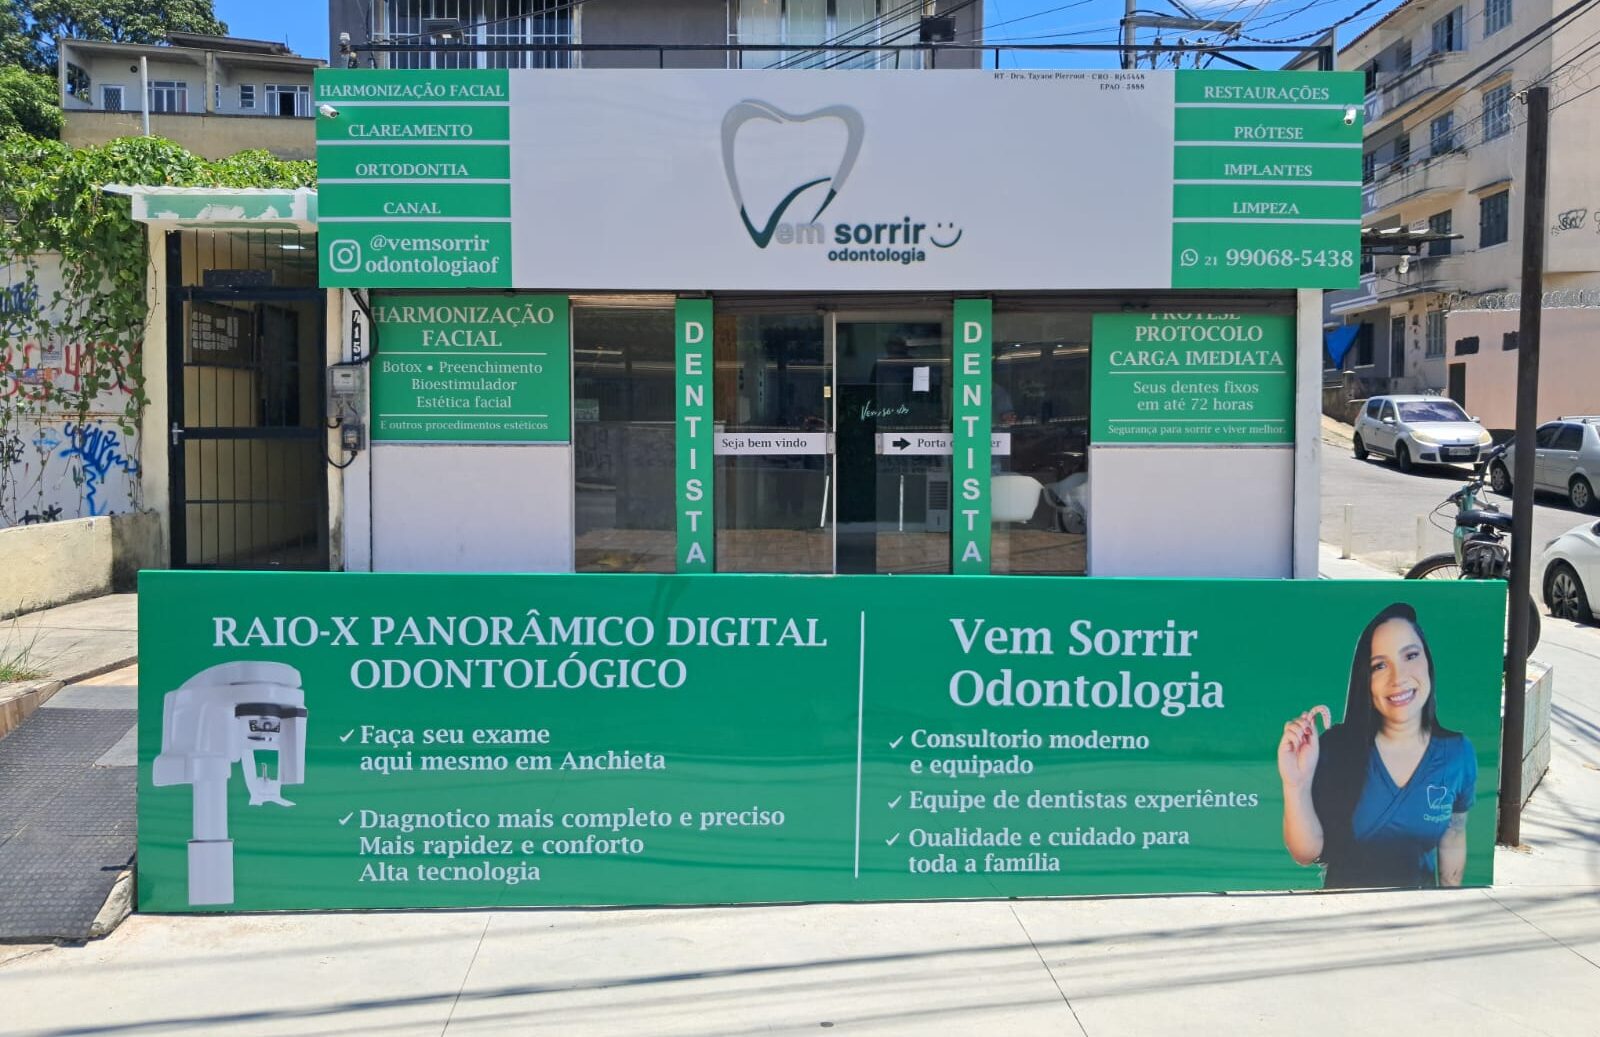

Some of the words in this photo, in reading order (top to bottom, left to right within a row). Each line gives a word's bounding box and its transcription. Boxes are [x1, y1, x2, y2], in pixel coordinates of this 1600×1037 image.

[320, 83, 445, 98] HARMONIZAÇÃO
[451, 85, 504, 96] FACIAL
[1205, 85, 1329, 102] RESTAURAÇÕES
[348, 125, 472, 136] CLAREAMENTO
[1235, 125, 1303, 139] PRÓTESE
[356, 164, 468, 176] ORTODONTIA
[1225, 164, 1312, 176] IMPLANTES
[384, 203, 440, 214] CANAL
[1233, 202, 1299, 214] LIMPEZA
[834, 216, 926, 244] sorrir
[370, 235, 489, 251] @vemsorrir
[828, 247, 926, 265] odontologia
[1205, 256, 1217, 265] 21
[1226, 249, 1353, 267] 99068-5438
[365, 256, 499, 276] odontologiaof
[371, 303, 554, 328] HARMONIZAÇÃO
[423, 330, 502, 346] FACIAL
[1136, 326, 1262, 341] PROTOCOLO
[383, 361, 422, 372] Botox
[440, 361, 542, 373] Preenchimento
[1110, 351, 1179, 366] CARGA
[1186, 351, 1282, 365] IMEDIATA
[412, 378, 517, 390] Bioestimulador
[1133, 381, 1166, 394] Seus
[1171, 381, 1219, 393] dentes
[1224, 381, 1259, 393] fixos
[417, 396, 470, 407] Estética
[476, 396, 511, 408] facial
[1137, 400, 1159, 410] em
[1164, 398, 1185, 410] até
[1191, 398, 1208, 410] 72
[1213, 398, 1254, 410] horas
[380, 420, 386, 430] E
[389, 420, 422, 430] outros
[425, 419, 501, 432] procedimentos
[504, 420, 548, 430] estéticos
[1108, 425, 1157, 435] Segurança
[1160, 427, 1182, 436] para
[1184, 425, 1211, 434] sorrir
[1223, 425, 1246, 434] viver
[685, 322, 705, 563] DENTISTA
[722, 438, 745, 451] Seja
[748, 437, 772, 448] bem
[775, 437, 807, 448] vindo
[917, 438, 946, 448] Porta
[962, 322, 982, 561] DENTISTA
[213, 617, 358, 646] RAIO-X
[372, 609, 654, 646] PANORÂMICO
[667, 617, 827, 646] DIGITAL
[950, 619, 1053, 654] Vem
[1069, 620, 1198, 656] Sorrir
[351, 652, 686, 689] ODONTOLÓGICO
[950, 669, 1224, 717] Odontologia
[360, 726, 414, 748] Faça
[423, 729, 464, 744] seu
[472, 729, 549, 743] exame
[911, 729, 1042, 748] Consultorio
[1049, 730, 1149, 749] moderno
[360, 752, 413, 775] aqui
[421, 756, 508, 770] mesmo
[516, 756, 552, 770] em
[560, 751, 666, 770] Anchieta
[910, 760, 922, 774] e
[930, 755, 1034, 778] equipado
[910, 790, 985, 813] Equipe
[994, 790, 1019, 808] de
[1027, 790, 1127, 808] dentistas
[1135, 789, 1258, 812] experiêntes
[498, 809, 553, 828] mais
[562, 808, 672, 831] completo
[680, 812, 692, 826] e
[700, 806, 784, 830] preciso
[360, 835, 414, 854] Mais
[423, 835, 512, 858] rapidez
[521, 840, 534, 854] e
[543, 835, 643, 853] conforto
[1030, 832, 1040, 845] e
[1048, 827, 1135, 845] cuidado
[1142, 831, 1189, 849] para
[909, 854, 957, 872] toda
[965, 859, 976, 872] a
[984, 853, 1060, 872] família
[359, 862, 408, 881] Alta
[418, 861, 540, 885] tecnologia
